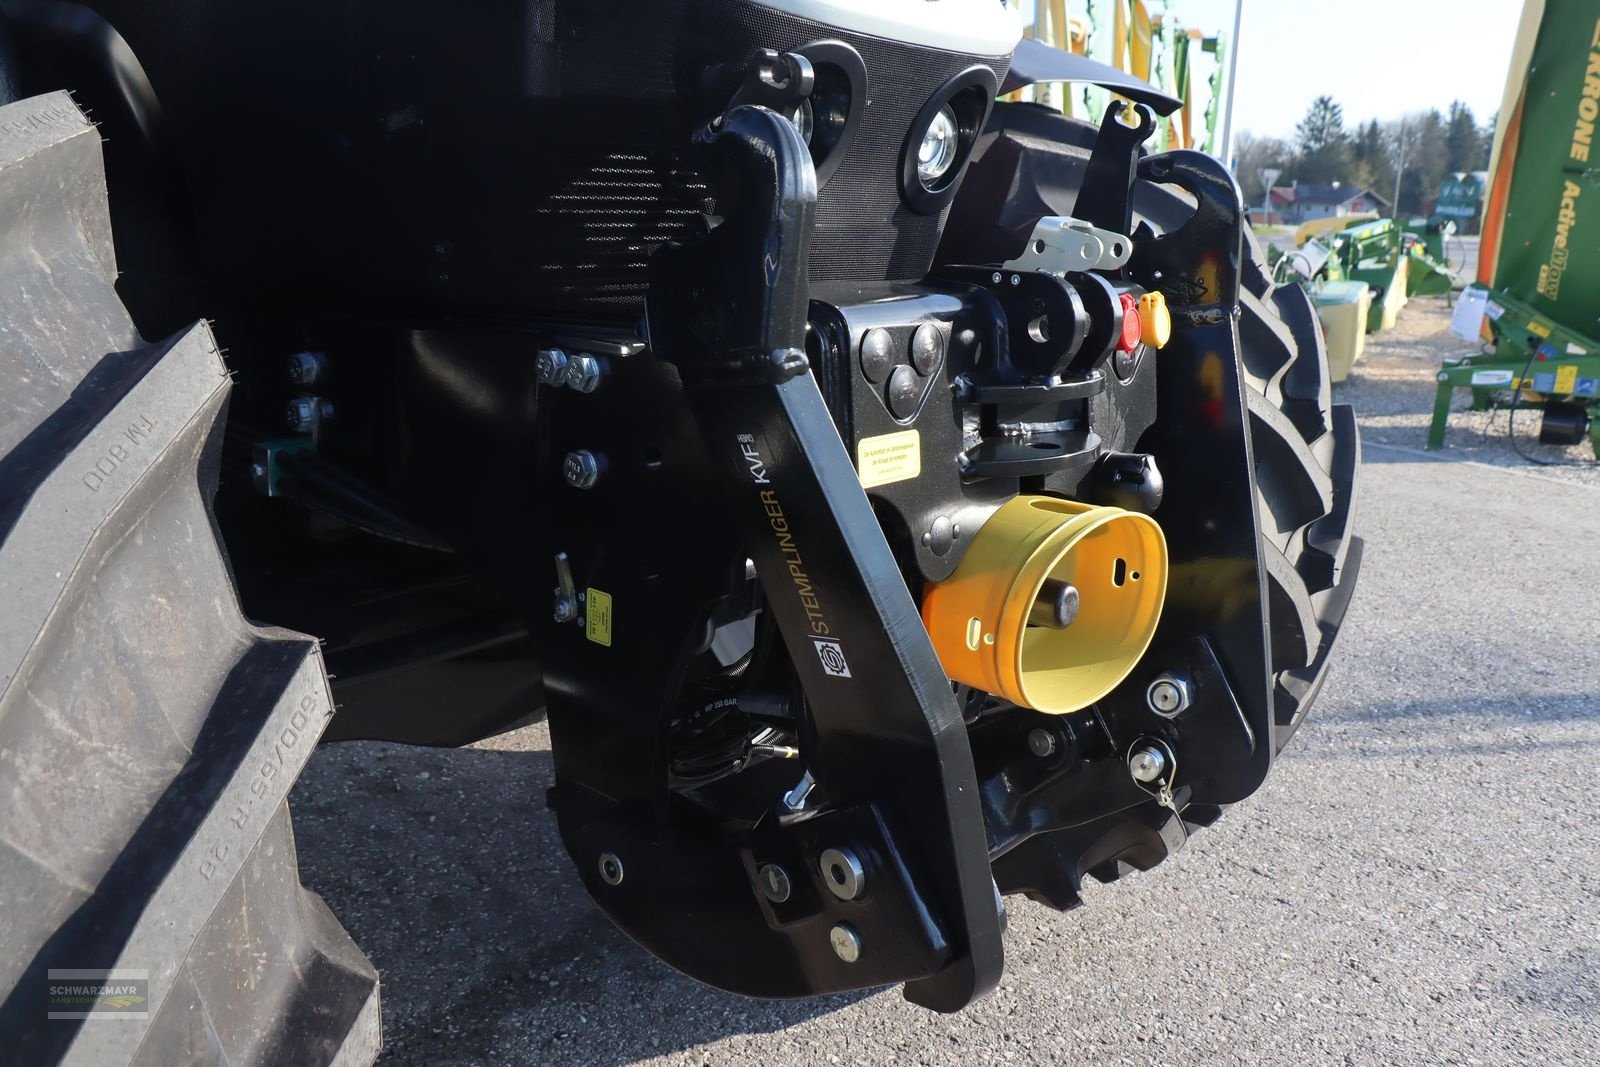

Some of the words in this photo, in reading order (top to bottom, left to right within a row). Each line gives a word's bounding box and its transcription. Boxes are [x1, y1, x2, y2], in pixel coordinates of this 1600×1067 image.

[1543, 180, 1581, 301] ActiveMow
[123, 413, 159, 446] TM
[82, 444, 128, 492] 800
[740, 444, 771, 484] KVF
[760, 490, 829, 635] STEMPLINGER
[724, 698, 738, 706] BAR
[230, 807, 249, 830] R
